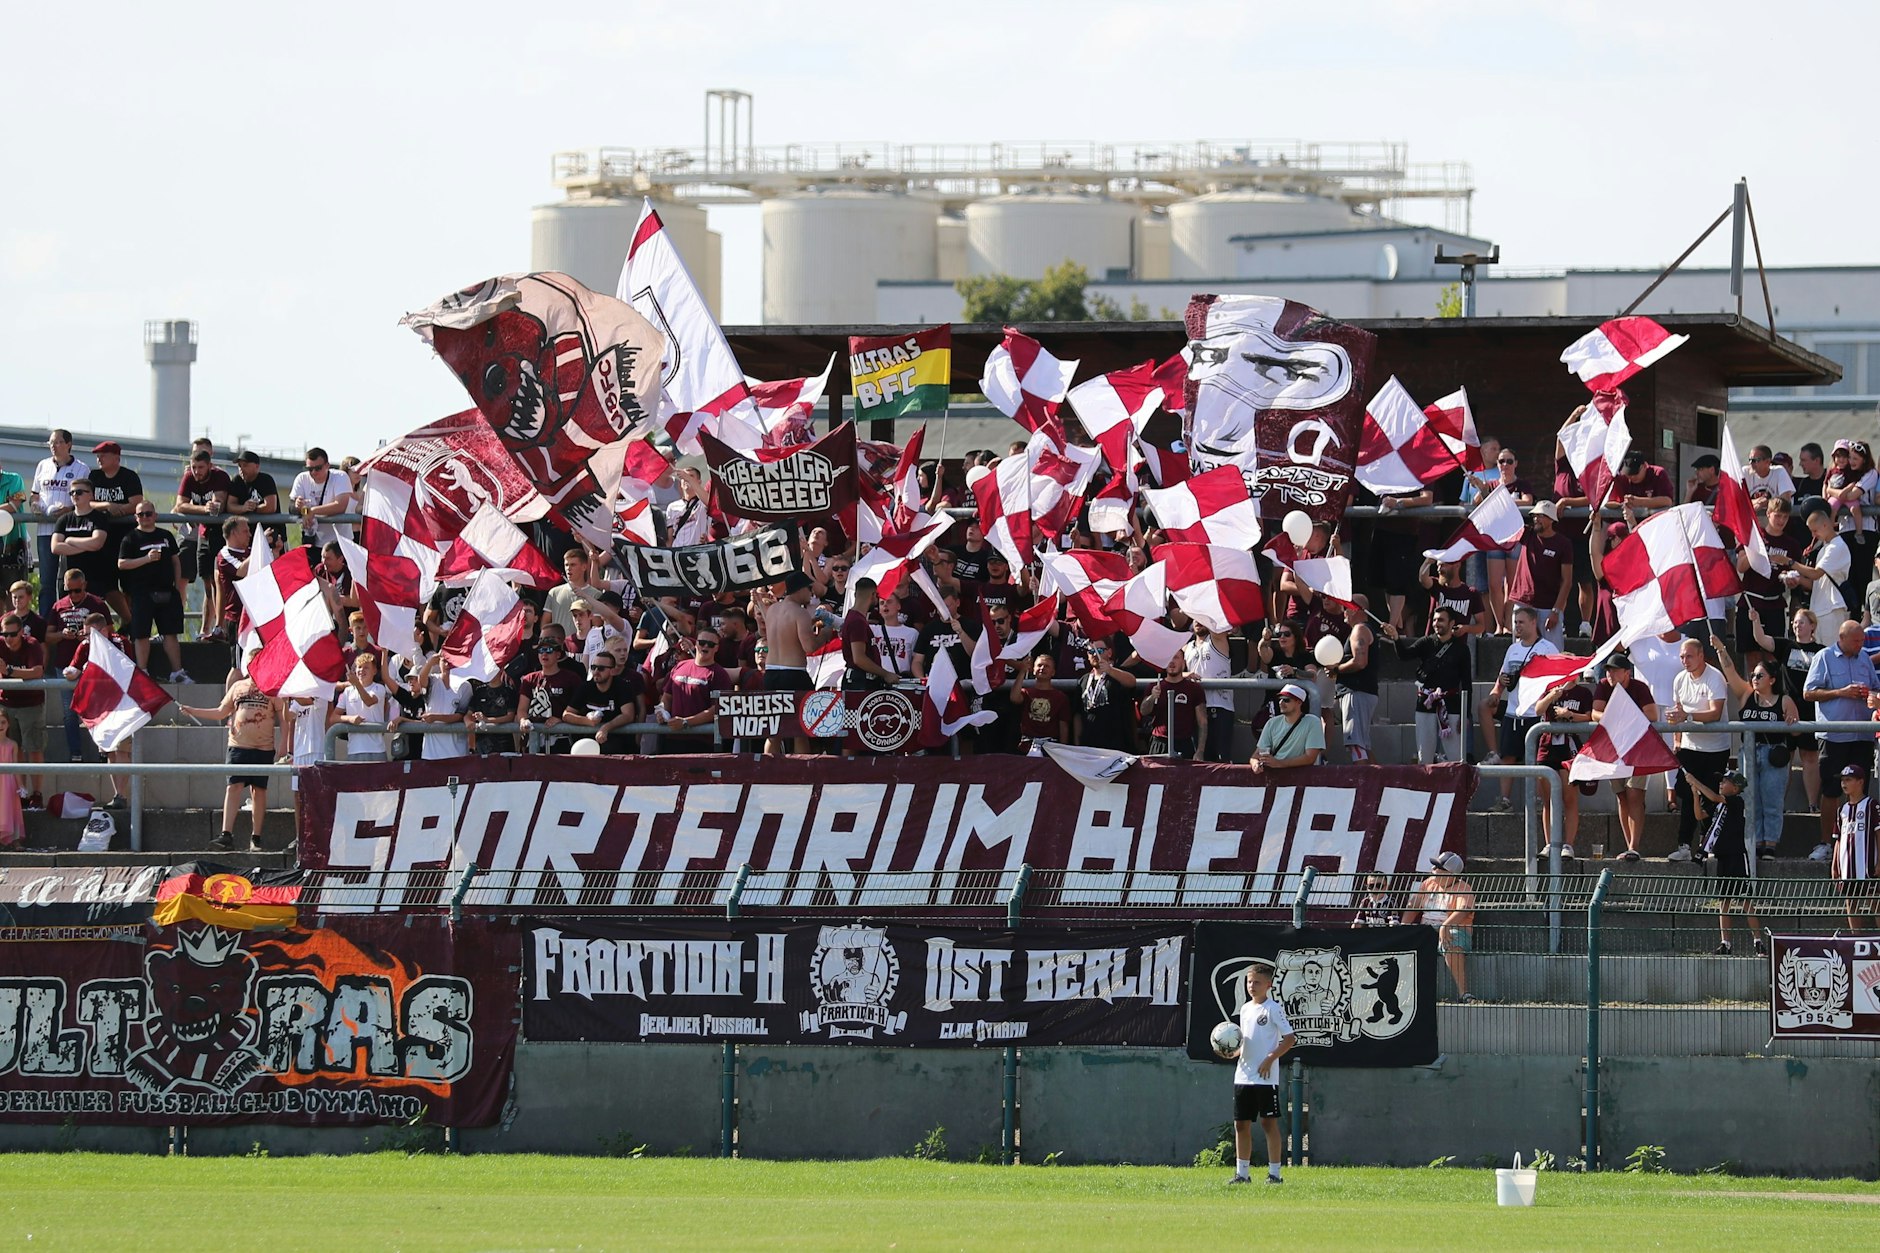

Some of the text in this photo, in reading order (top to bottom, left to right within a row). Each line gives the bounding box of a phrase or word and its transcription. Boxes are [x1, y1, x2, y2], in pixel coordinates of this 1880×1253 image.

[850, 337, 922, 377] ULTRAS
[856, 367, 916, 409] BFC
[725, 451, 830, 485] OBERLIGA
[734, 480, 827, 511] KRIEEEG
[620, 528, 795, 589] 19 66
[718, 693, 796, 716] SCHEISS
[732, 714, 781, 737] NOFV
[317, 780, 1456, 913] SPORTFORUM BLEIBT!
[531, 927, 789, 1005] FRAKTION-H
[923, 935, 1186, 1010] OST BERLIN
[639, 1013, 769, 1037] BERLINER FUSSBALL
[939, 1020, 1029, 1041] CLUB DYNAMO
[1797, 1013, 1834, 1024] 1954
[118, 1091, 239, 1115] FUSSBALL
[304, 1088, 422, 1119] DYNAMO
